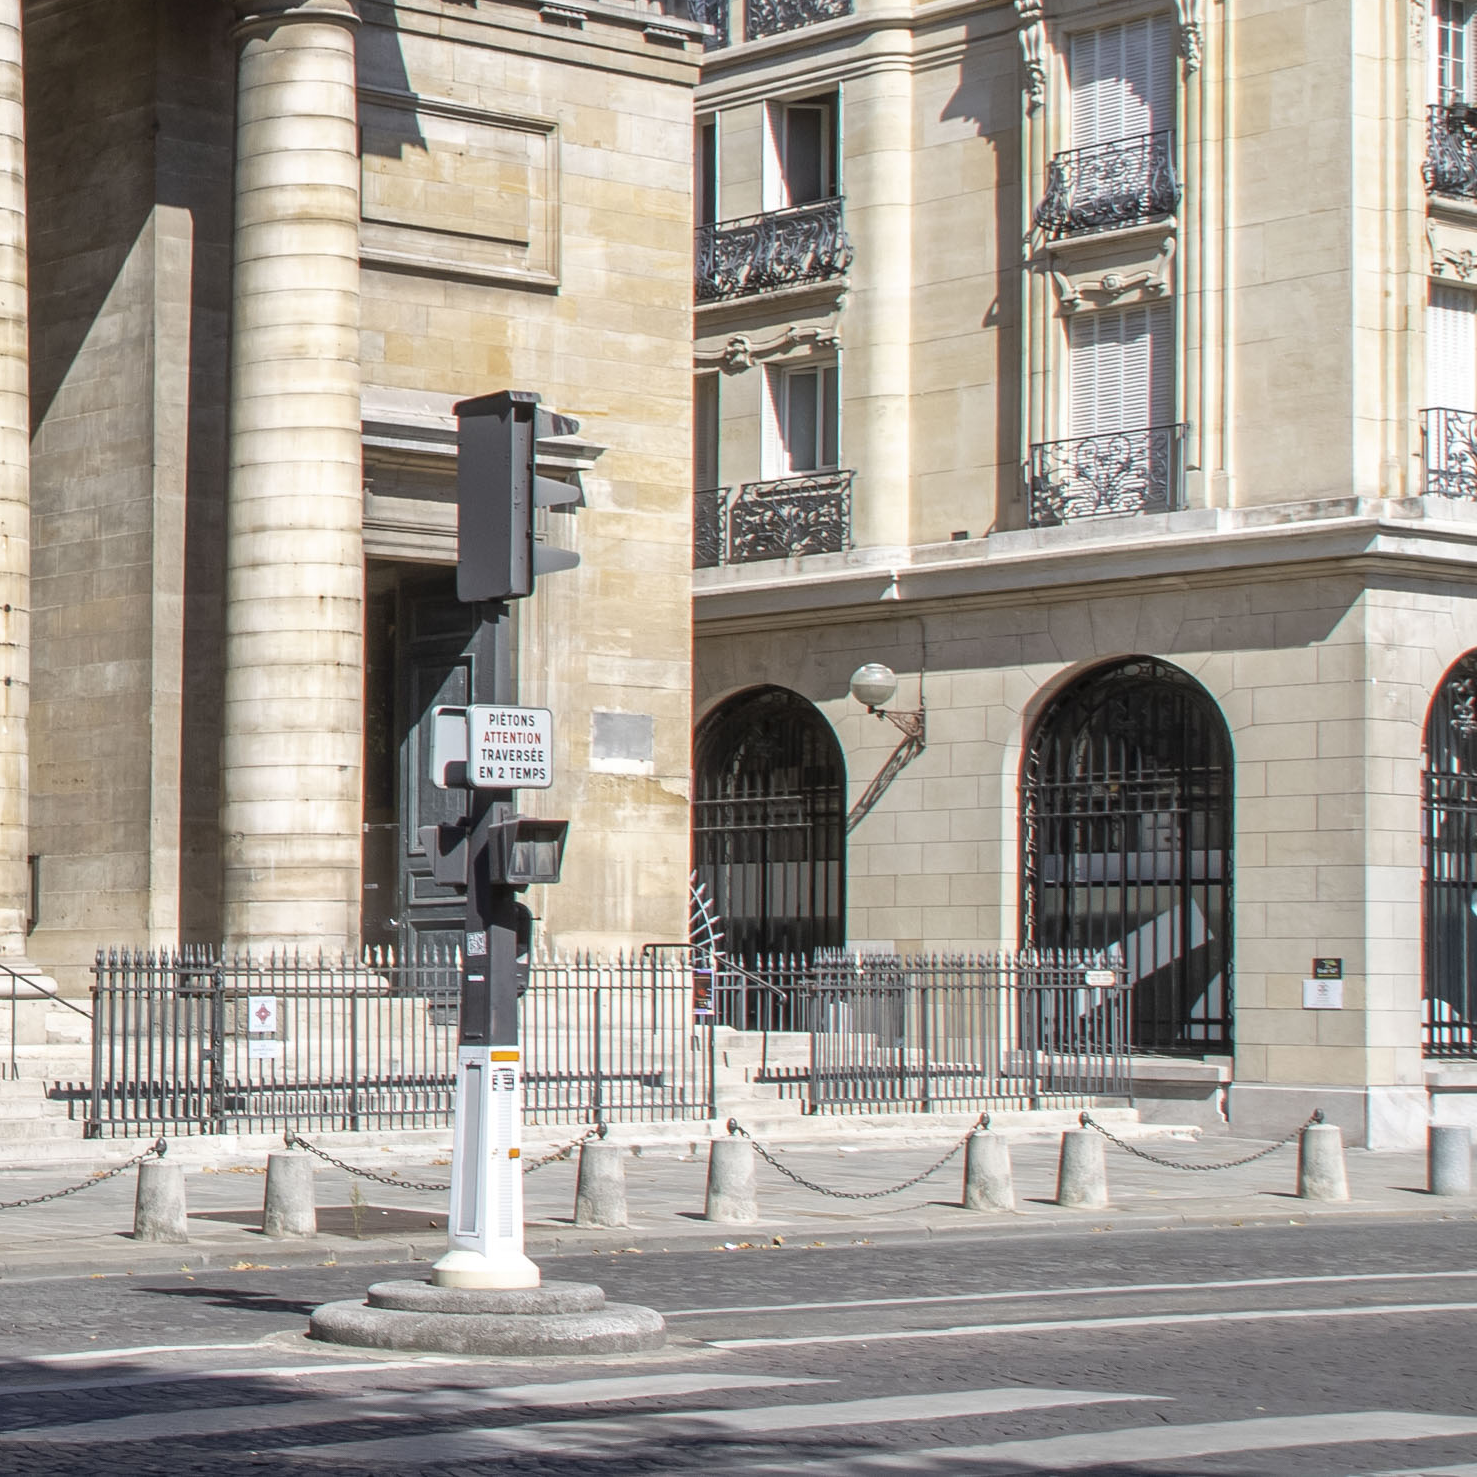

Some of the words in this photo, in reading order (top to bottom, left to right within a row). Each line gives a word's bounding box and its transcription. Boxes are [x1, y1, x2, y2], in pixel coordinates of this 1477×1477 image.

[489, 711, 535, 727] PIÉTONS
[484, 731, 541, 744] ATTENTION
[481, 747, 544, 762] TRAVERSÉE
[479, 766, 493, 778] EN
[497, 766, 504, 778] 2
[509, 767, 546, 779] TEMPS
